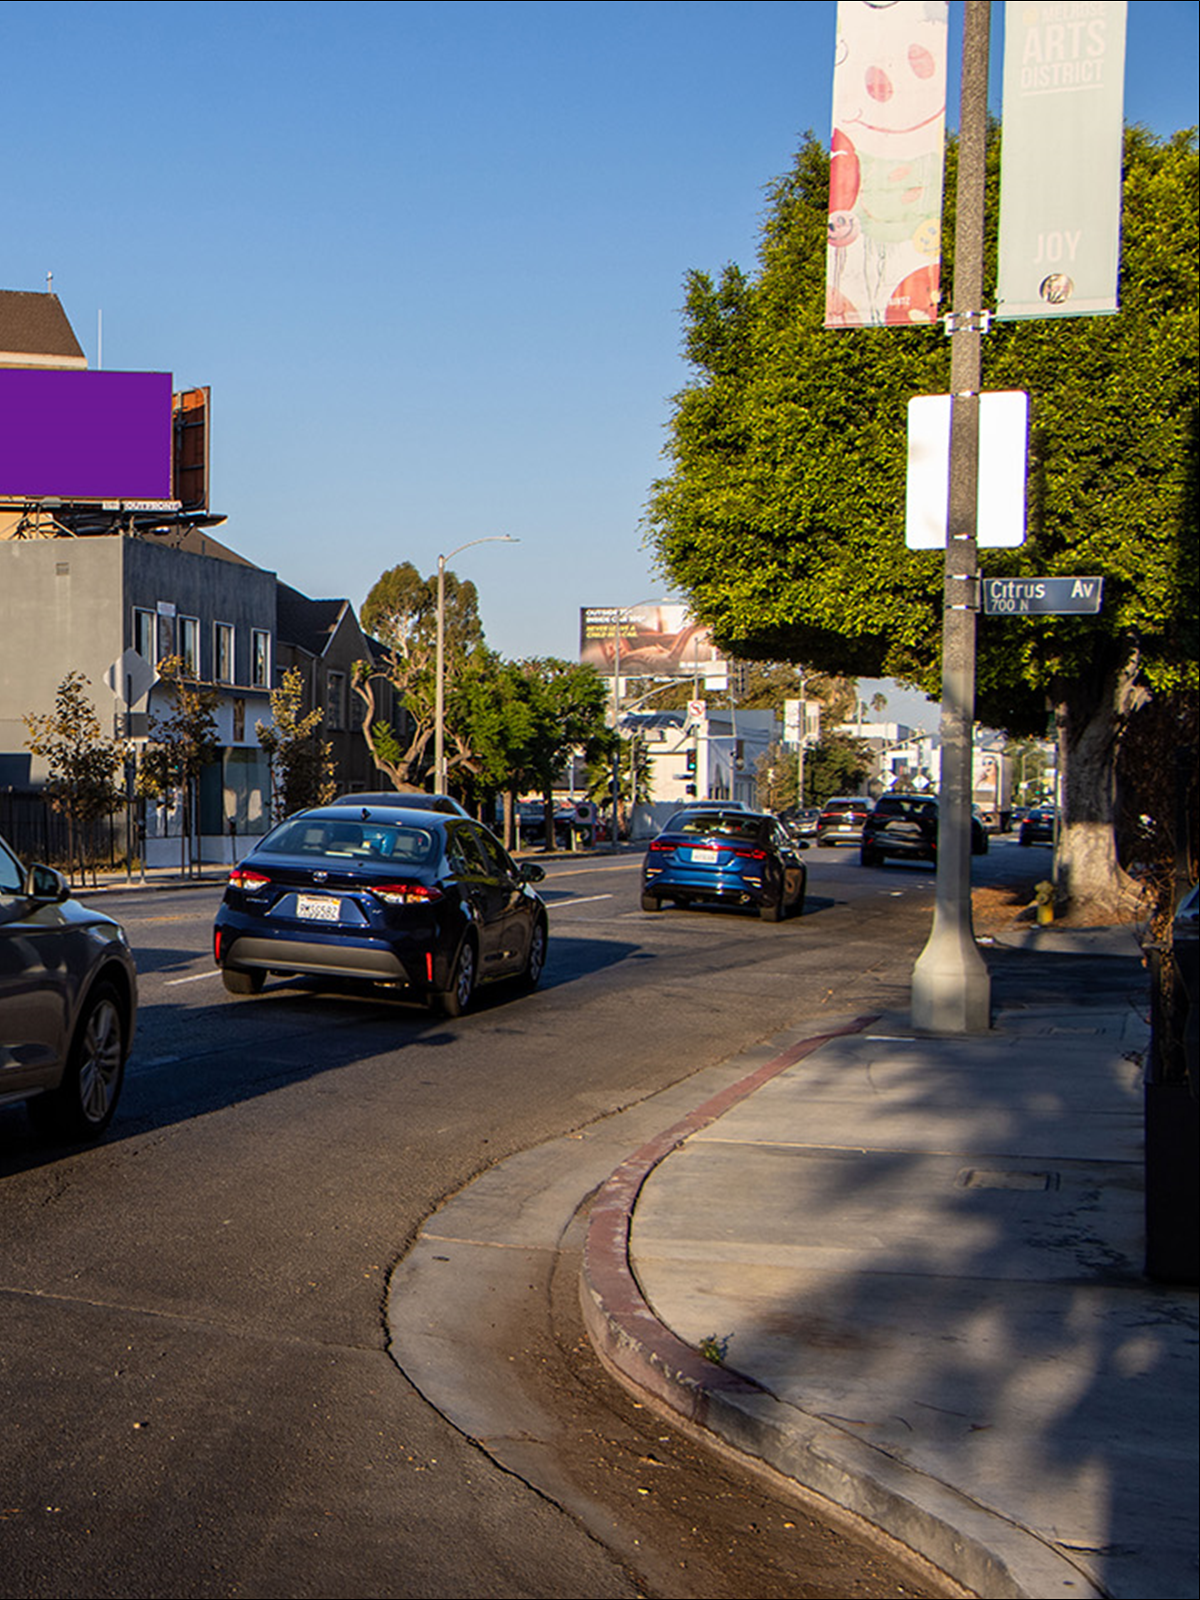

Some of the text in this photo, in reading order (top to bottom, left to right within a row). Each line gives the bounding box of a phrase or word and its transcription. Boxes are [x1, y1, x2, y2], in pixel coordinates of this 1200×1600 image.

[1022, 20, 1105, 64] ARTS
[1021, 59, 1105, 88] DISTRICT
[1033, 230, 1082, 264] JOY
[990, 579, 1094, 599] Citrus Av
[991, 600, 1030, 612] 700 N
